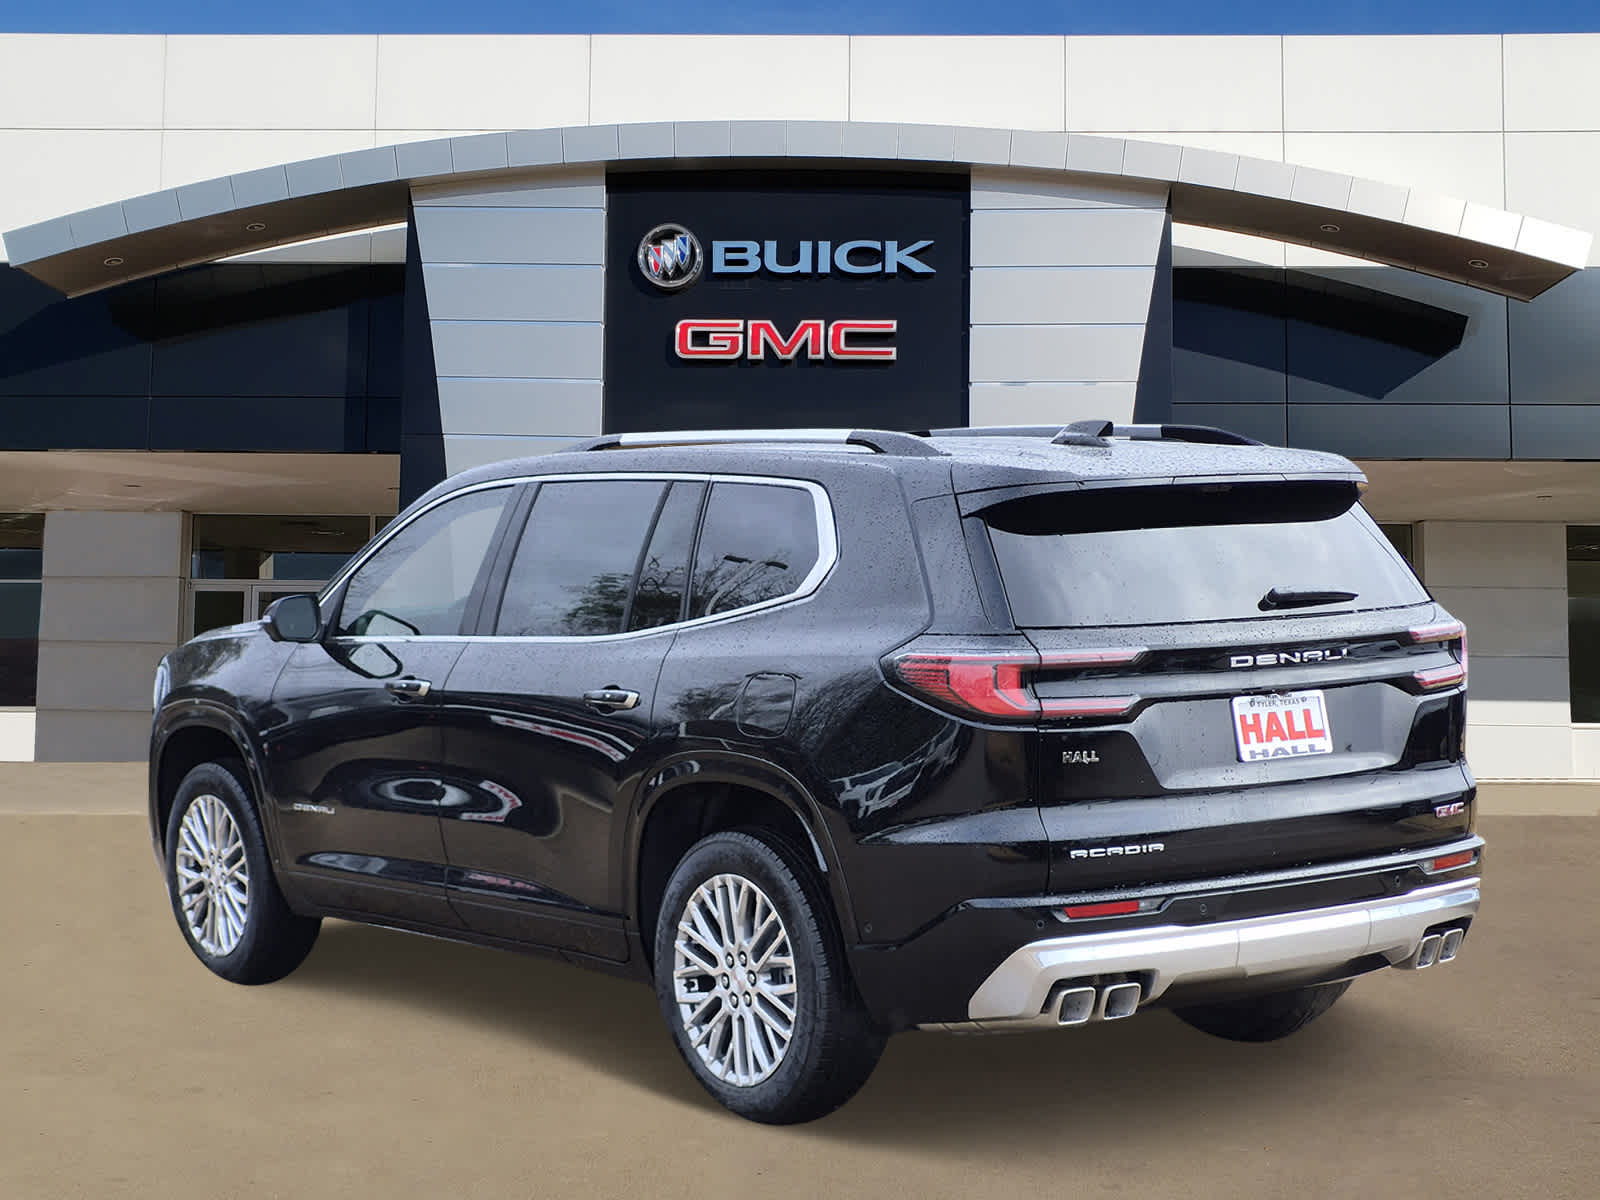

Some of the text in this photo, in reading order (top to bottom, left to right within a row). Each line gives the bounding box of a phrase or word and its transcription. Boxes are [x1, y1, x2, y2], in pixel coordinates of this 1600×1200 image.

[711, 240, 937, 273] BUICK
[674, 319, 897, 361] GMC
[1230, 648, 1348, 668] DENALI
[1280, 698, 1300, 706] TEXAS
[1240, 708, 1325, 745] HALL
[1062, 750, 1100, 764] HALL
[1249, 744, 1326, 759] HALL
[1070, 843, 1165, 859] ACADIA
